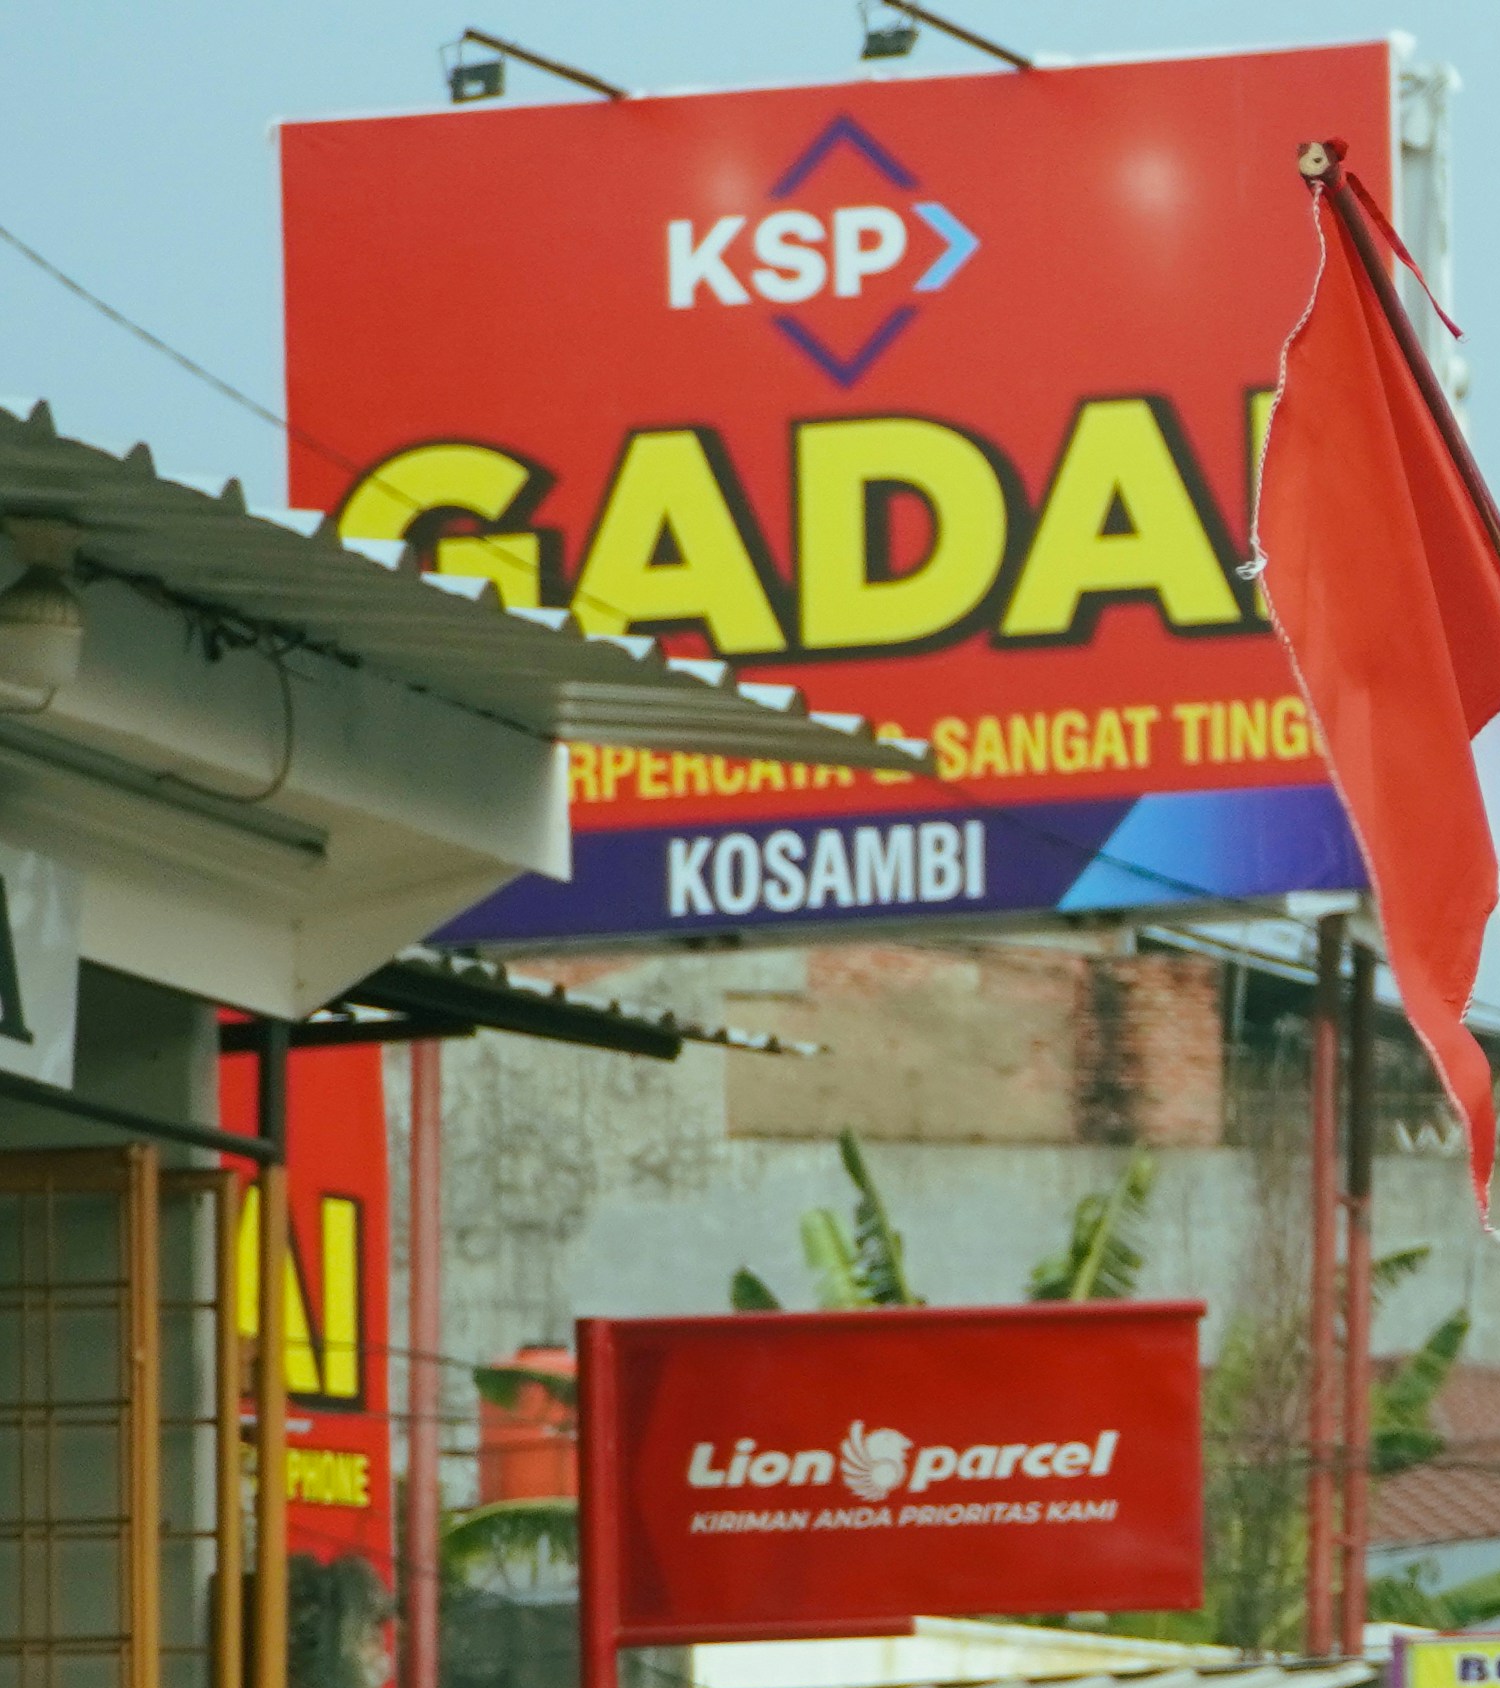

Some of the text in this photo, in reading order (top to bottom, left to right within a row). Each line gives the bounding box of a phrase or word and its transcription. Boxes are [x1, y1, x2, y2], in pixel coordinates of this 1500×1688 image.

[667, 204, 908, 310] KSP
[932, 706, 1160, 782] SANGAT
[667, 819, 986, 918] KOSAMBI
[687, 1429, 1120, 1493] Lion parcel
[690, 1498, 1118, 1534] KIRIMAN ANDA PRIORITAS KAMI
